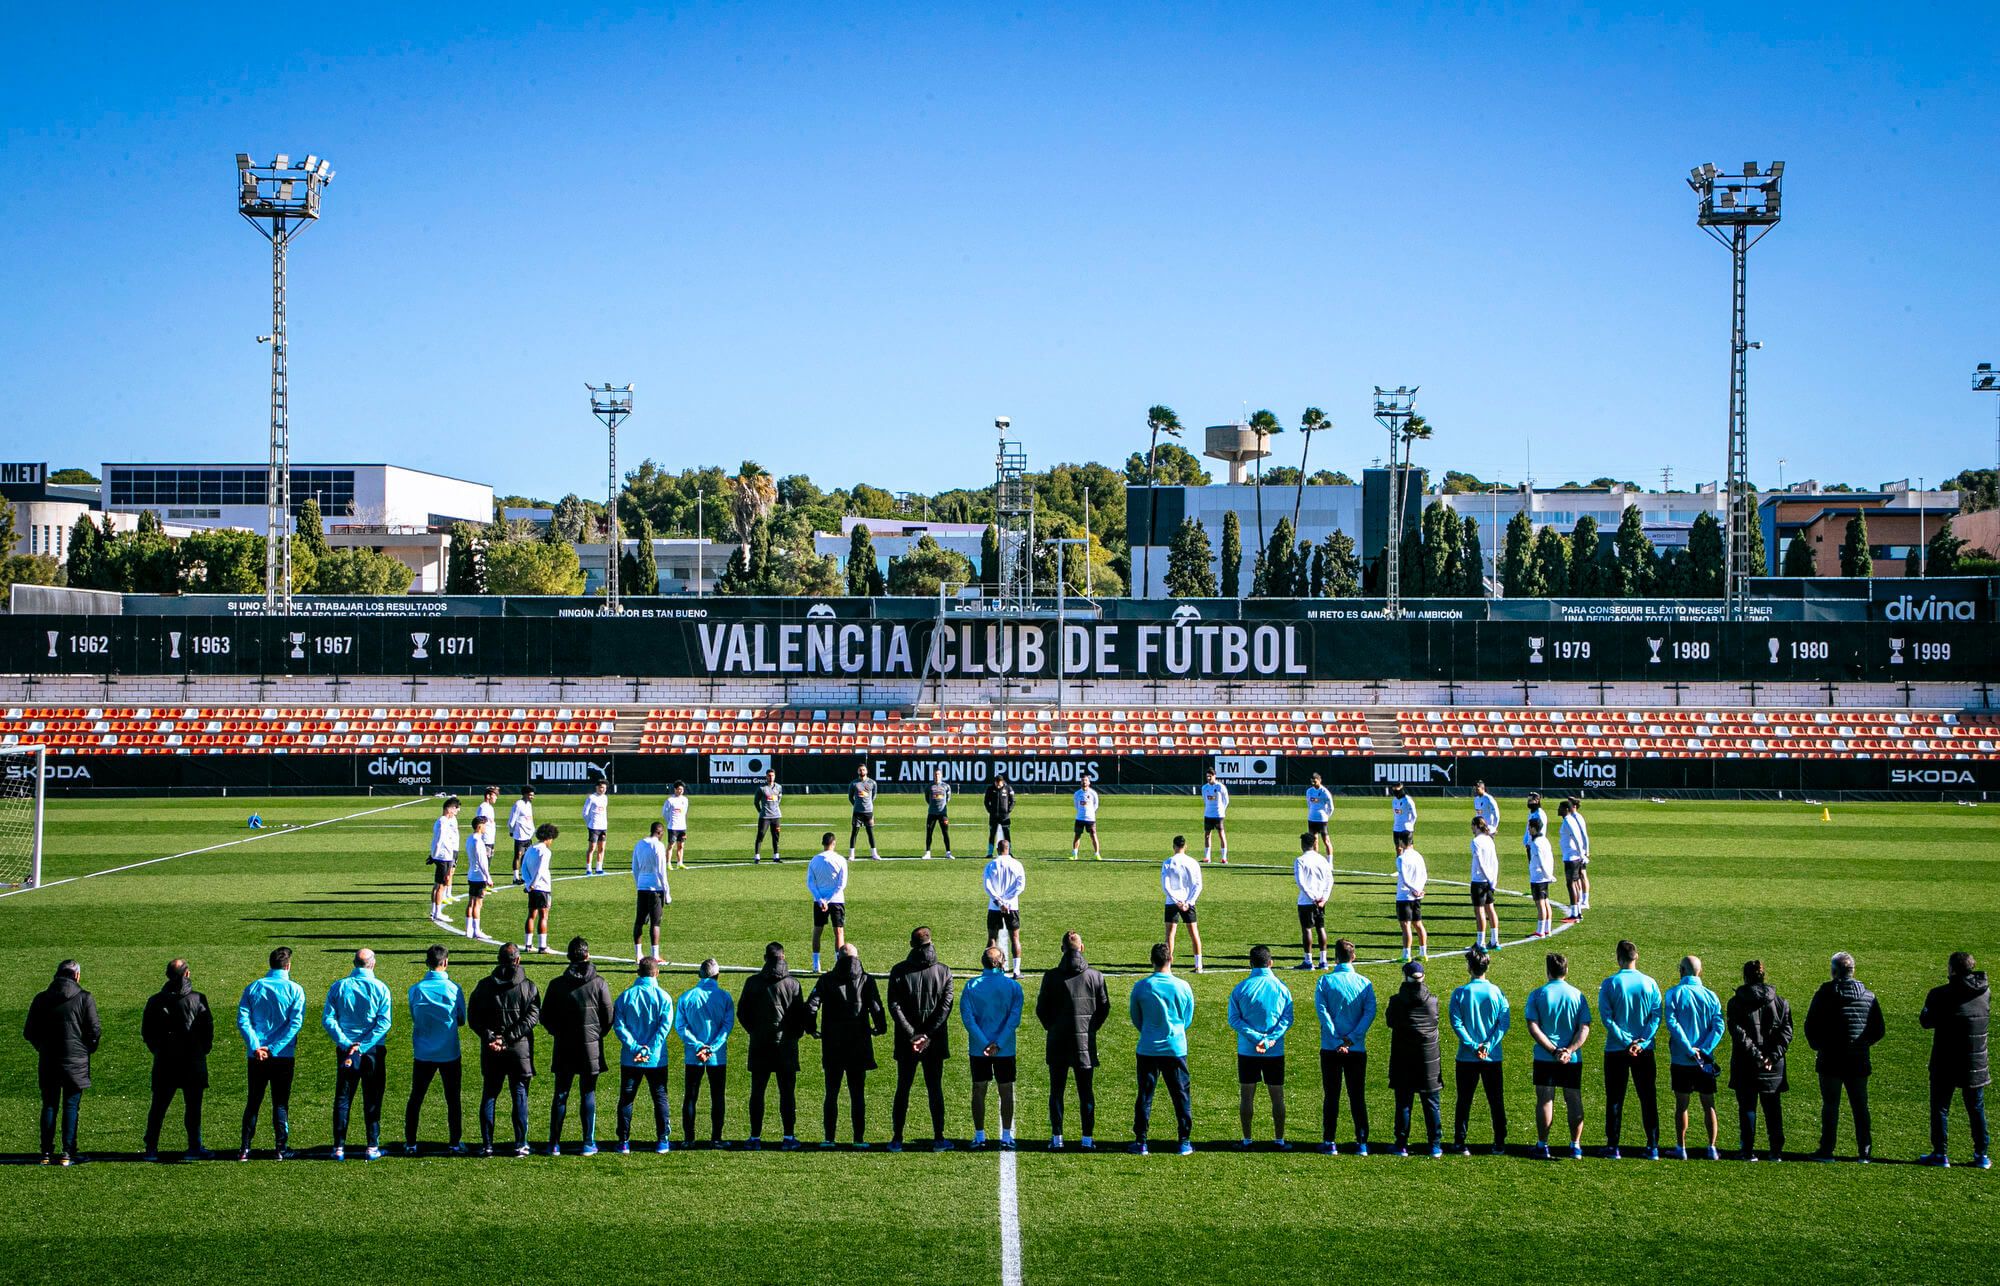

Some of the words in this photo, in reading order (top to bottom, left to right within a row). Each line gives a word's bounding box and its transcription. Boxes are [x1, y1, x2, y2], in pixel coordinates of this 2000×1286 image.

[228, 602, 237, 610] SI
[240, 602, 260, 610] UNO
[314, 603, 364, 611] TRABAJAR
[366, 603, 384, 611] LOS
[386, 603, 448, 611] RESULTADOS
[558, 607, 594, 618] NINGÚN
[642, 610, 654, 618] ES
[656, 610, 674, 618] TAN
[676, 610, 708, 618] BUENO
[1406, 610, 1416, 618] MI
[1418, 608, 1462, 618] AMBICIÓN
[1562, 606, 1586, 614] PARA
[1589, 606, 1642, 614] CONSEGUIR
[1646, 606, 1656, 614] EL
[1660, 604, 1686, 614] ÉXITO
[1885, 595, 1975, 621] divina
[70, 636, 108, 654] 1962
[192, 636, 230, 654] 1963
[314, 636, 352, 654] 1967
[438, 637, 474, 654] 1971
[698, 624, 912, 672] VALENCIA
[931, 625, 1044, 674] CLUB
[1064, 626, 1119, 674] DE
[1138, 619, 1307, 674] FÚTBOL
[1552, 642, 1591, 659] 1979
[1672, 642, 1710, 660] 1980
[1790, 642, 1828, 660] 1980
[1912, 642, 1951, 660] 1999
[368, 757, 432, 776] divina
[530, 762, 588, 780] PUMA
[714, 761, 734, 772] TM
[876, 760, 892, 781] E.
[899, 761, 986, 782] ANTONIO
[994, 761, 1099, 782] PUCHADES
[1219, 762, 1239, 773] TM
[1374, 763, 1431, 782] PUMA
[1554, 760, 1616, 778] divina
[398, 776, 431, 786] seguros
[1584, 780, 1616, 788] seguros
